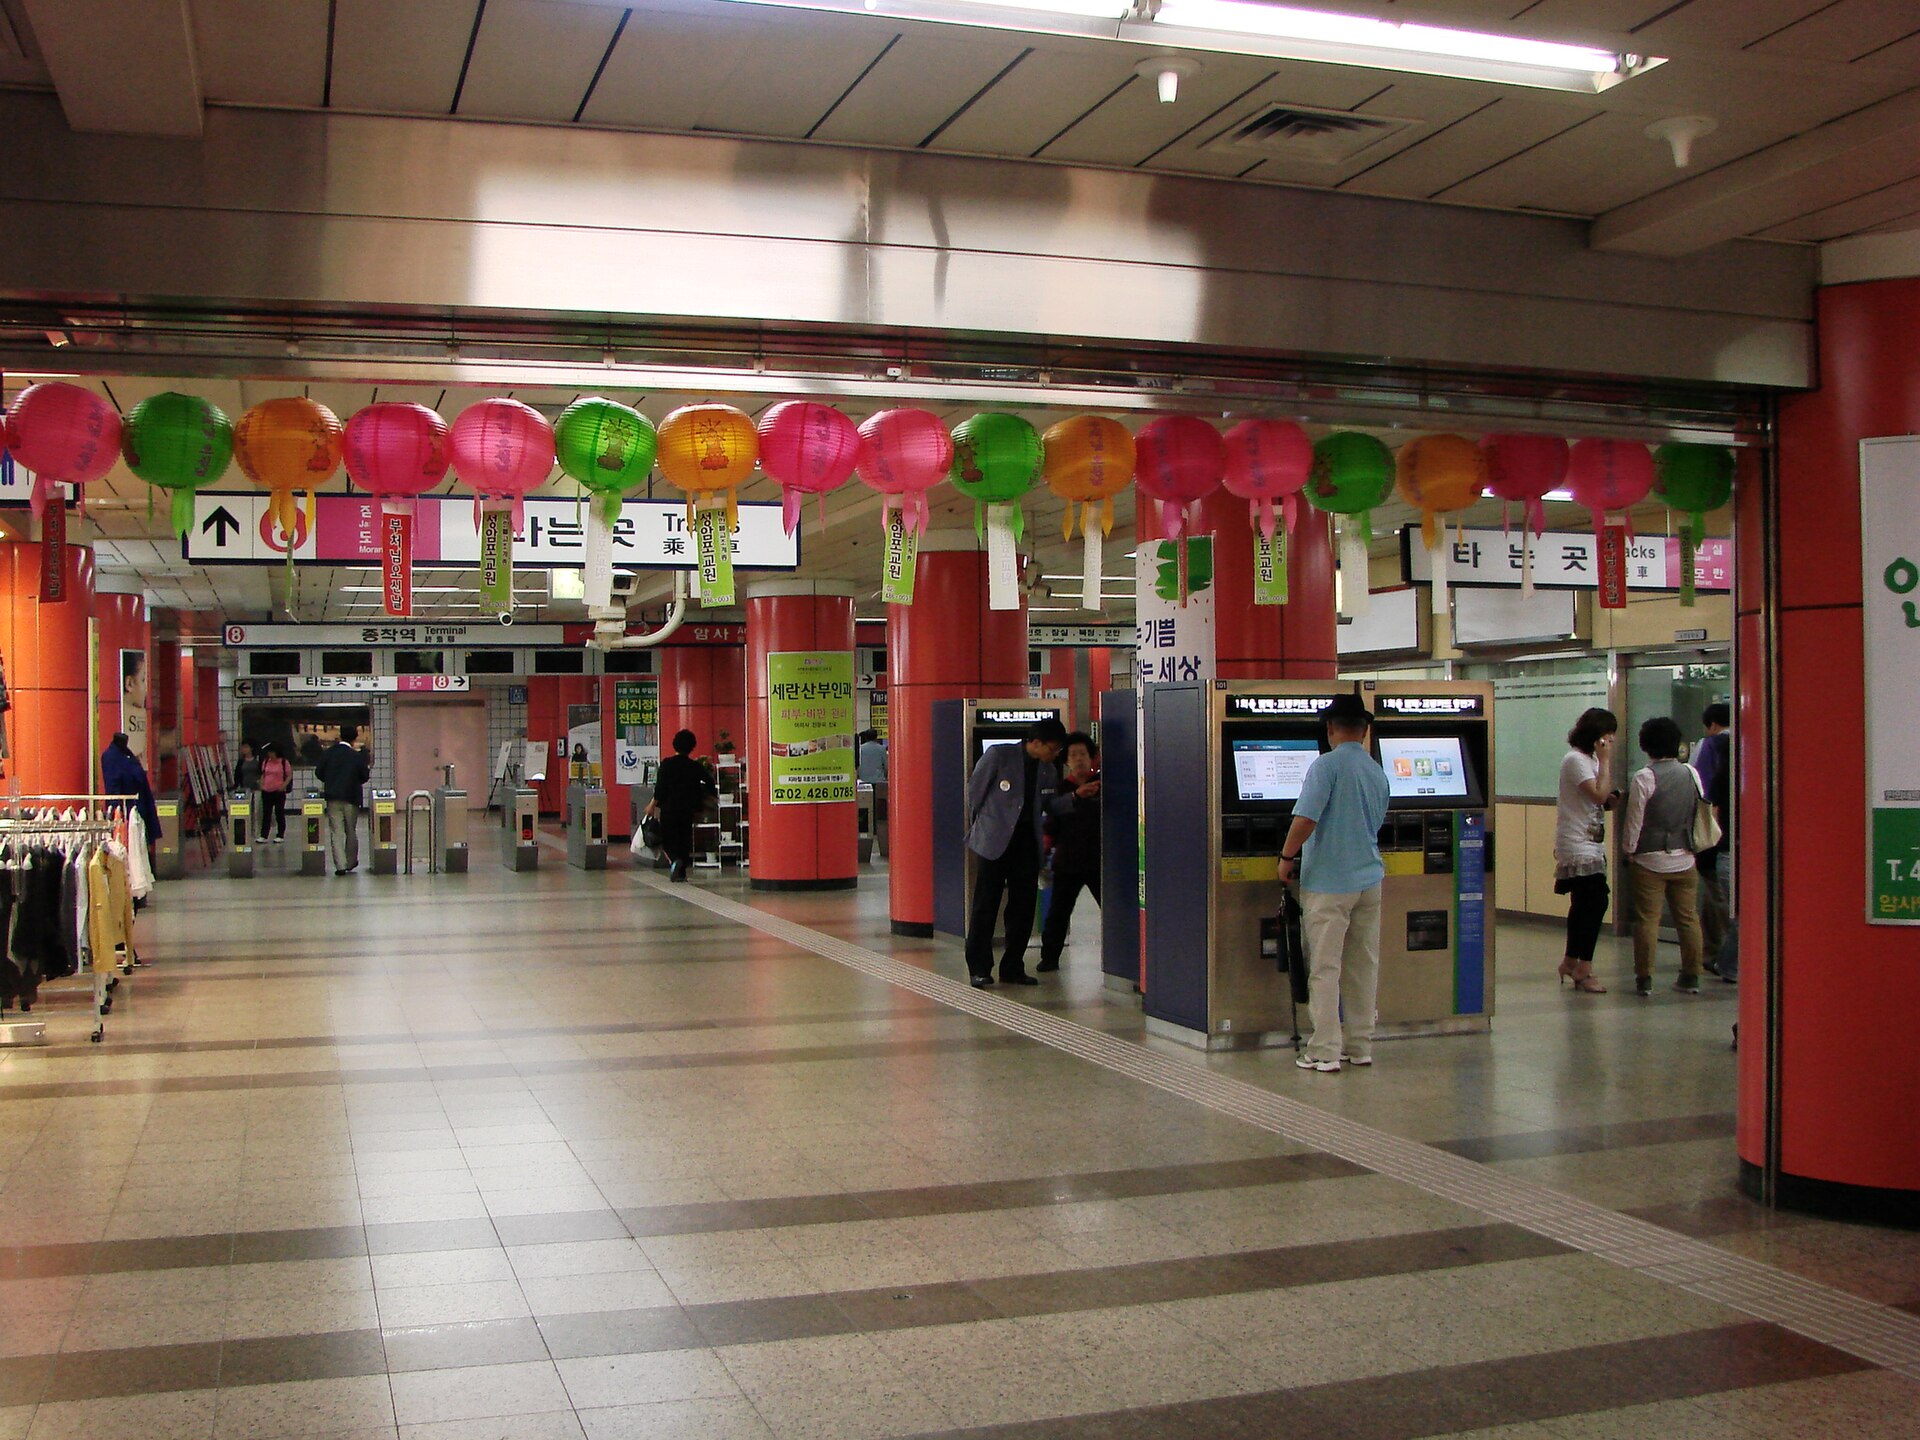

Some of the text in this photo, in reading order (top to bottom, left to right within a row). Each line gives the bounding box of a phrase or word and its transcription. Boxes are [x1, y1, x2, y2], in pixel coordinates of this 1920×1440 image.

[485, 514, 498, 586] 성암포교원
[700, 511, 717, 583] 성암포교원
[389, 519, 404, 611] 부처님오신날
[1693, 567, 1724, 580] 모란
[362, 628, 416, 643] 종착역
[424, 627, 467, 635] Terminal
[693, 627, 729, 640] 암사
[1145, 618, 1176, 648] 기쁨
[1159, 655, 1201, 683] 세상
[772, 682, 852, 700] 세란산부인과
